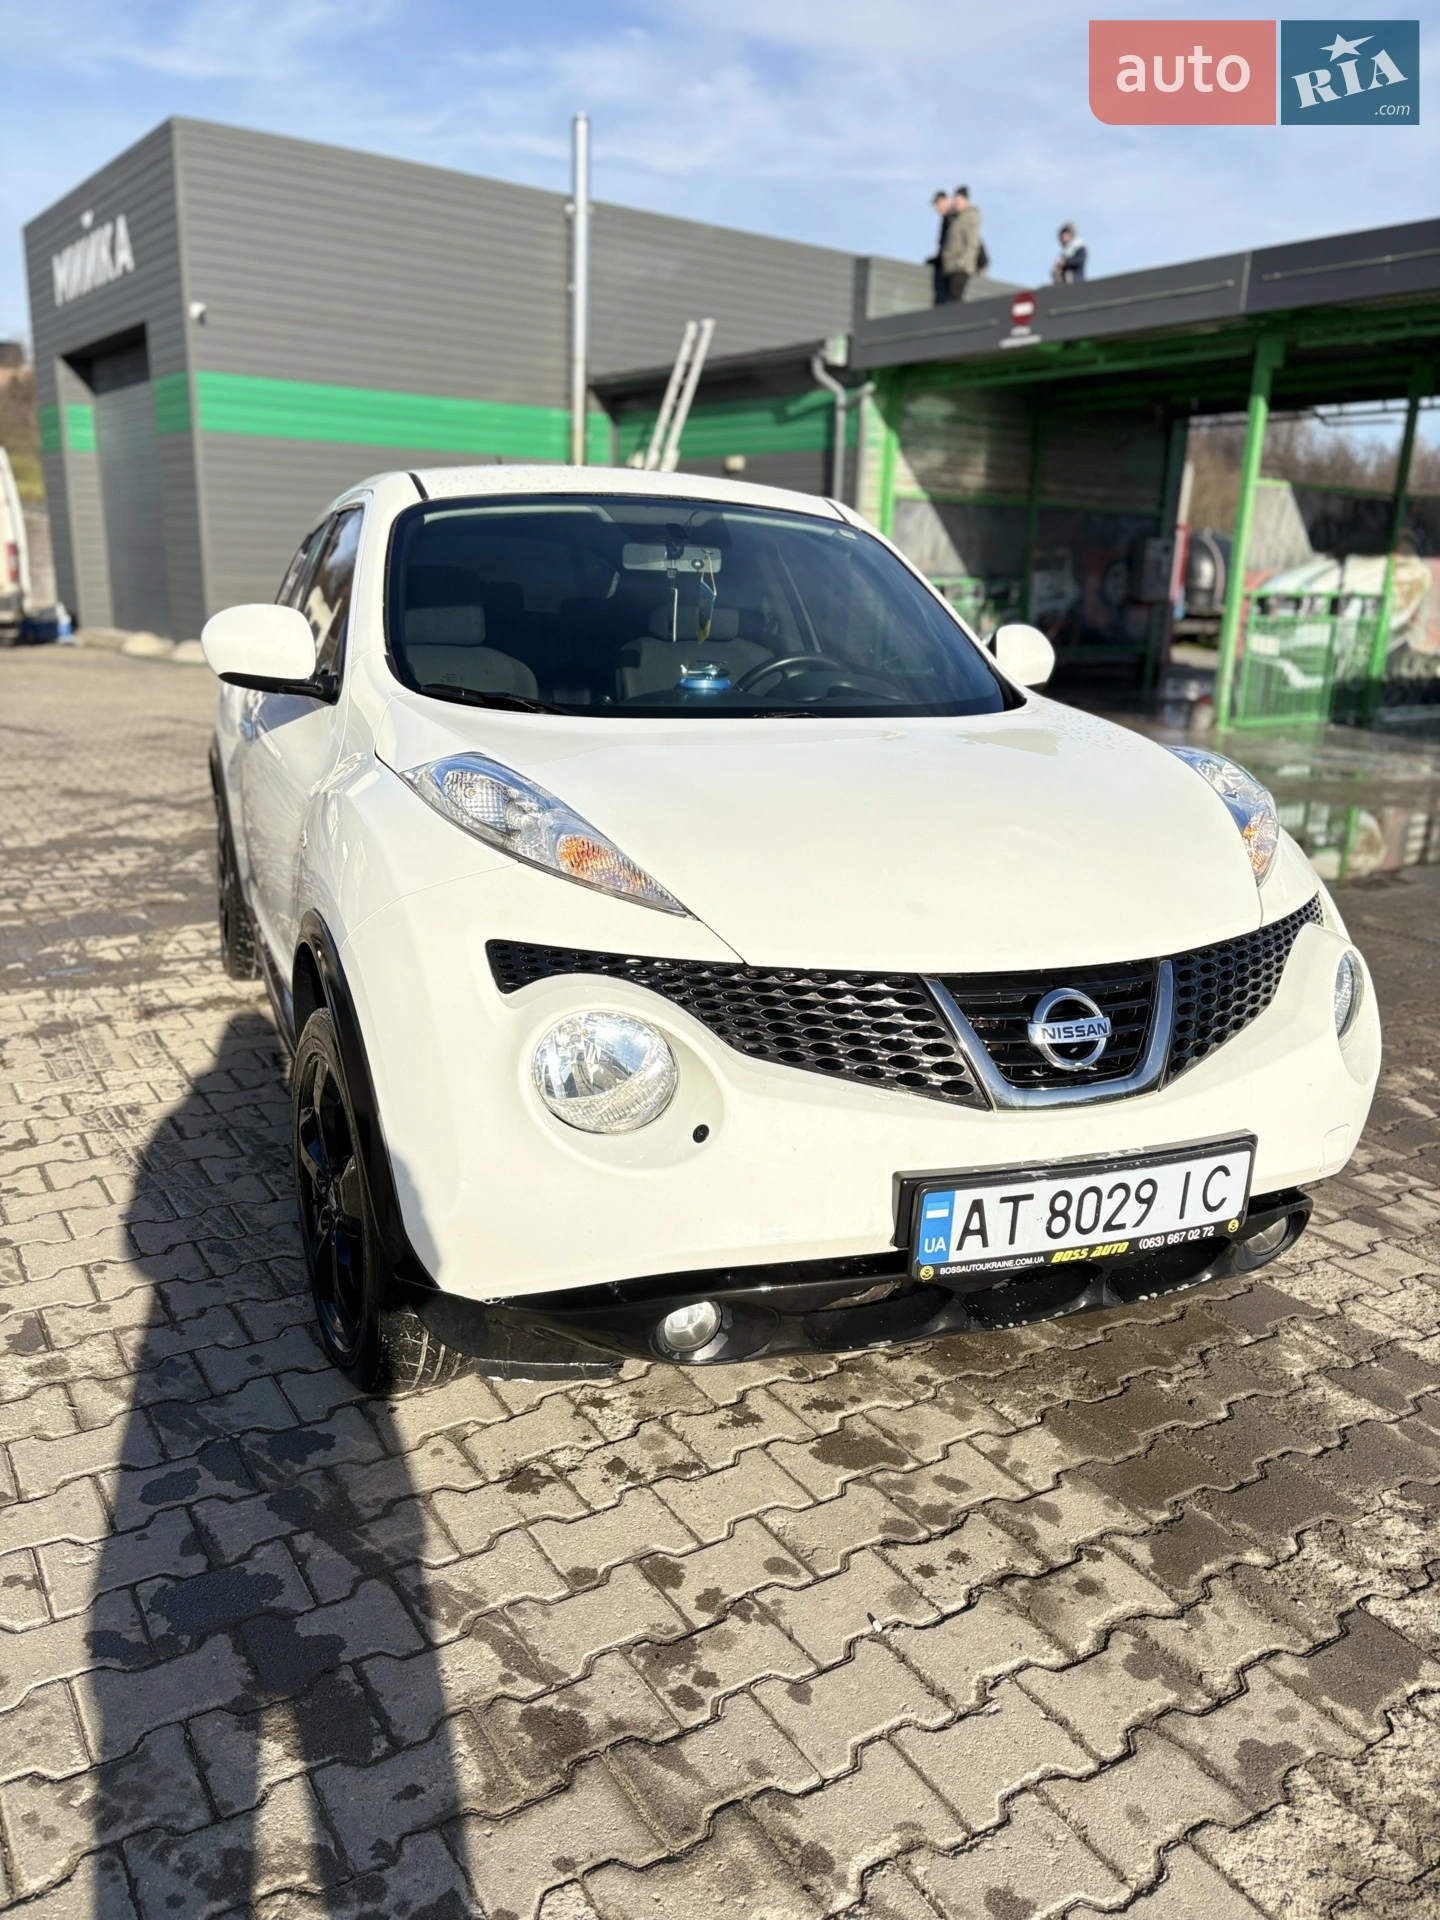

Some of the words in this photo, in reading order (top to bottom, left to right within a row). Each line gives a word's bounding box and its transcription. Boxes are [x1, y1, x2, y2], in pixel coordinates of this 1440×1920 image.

[1041, 1022, 1107, 1039] NISSAN
[956, 1194, 1034, 1251] AT
[1045, 1178, 1158, 1240] 8029
[1178, 1165, 1232, 1220] IC
[924, 1237, 947, 1254] UA
[940, 1256, 1044, 1275] BOSSAUTOUKRAINE.COM.UA
[1051, 1248, 1089, 1263] BOSS
[1090, 1242, 1129, 1257] AUTO
[1139, 1235, 1164, 1250] (063)
[1167, 1232, 1186, 1245] 667
[1187, 1229, 1200, 1241] 02
[1202, 1226, 1215, 1238] 72
